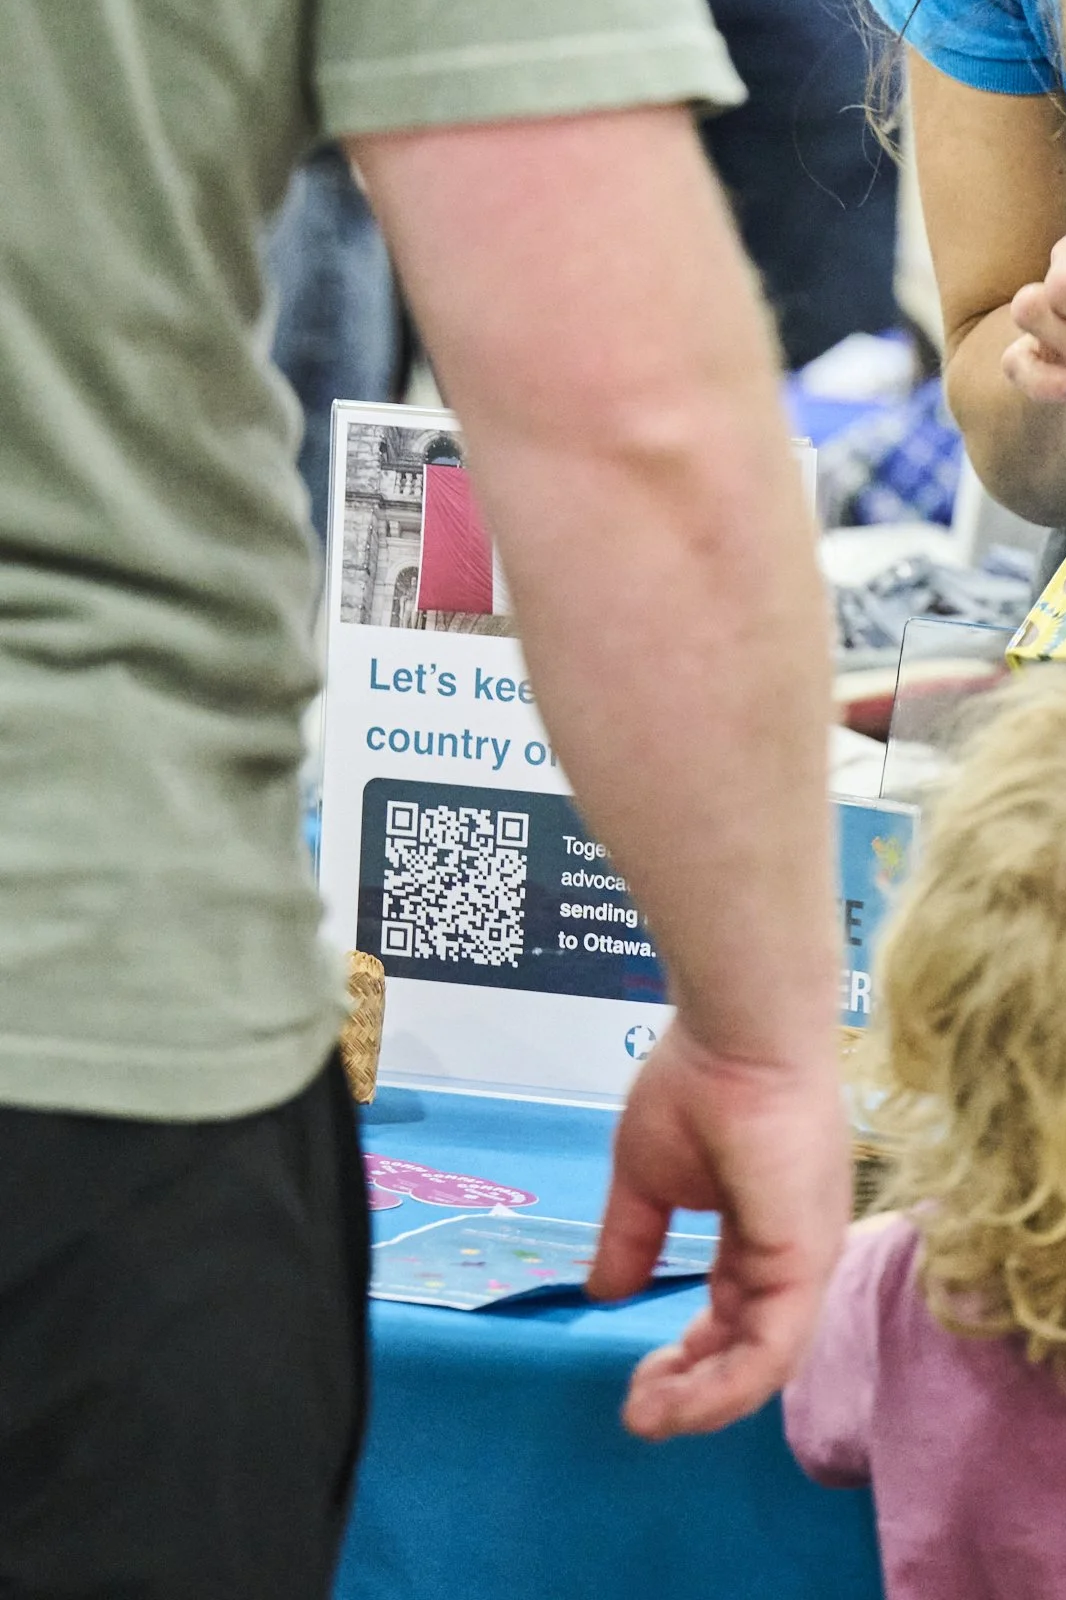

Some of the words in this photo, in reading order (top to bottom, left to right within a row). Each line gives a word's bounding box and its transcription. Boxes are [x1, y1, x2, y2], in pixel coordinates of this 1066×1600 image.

[370, 658, 457, 697] Let’s
[474, 667, 537, 704] kee
[366, 726, 511, 771] country
[562, 836, 611, 861] Toge
[561, 869, 630, 892] advoca
[560, 902, 638, 928] sending
[558, 931, 578, 950] to
[584, 932, 656, 958] Ottawa.
